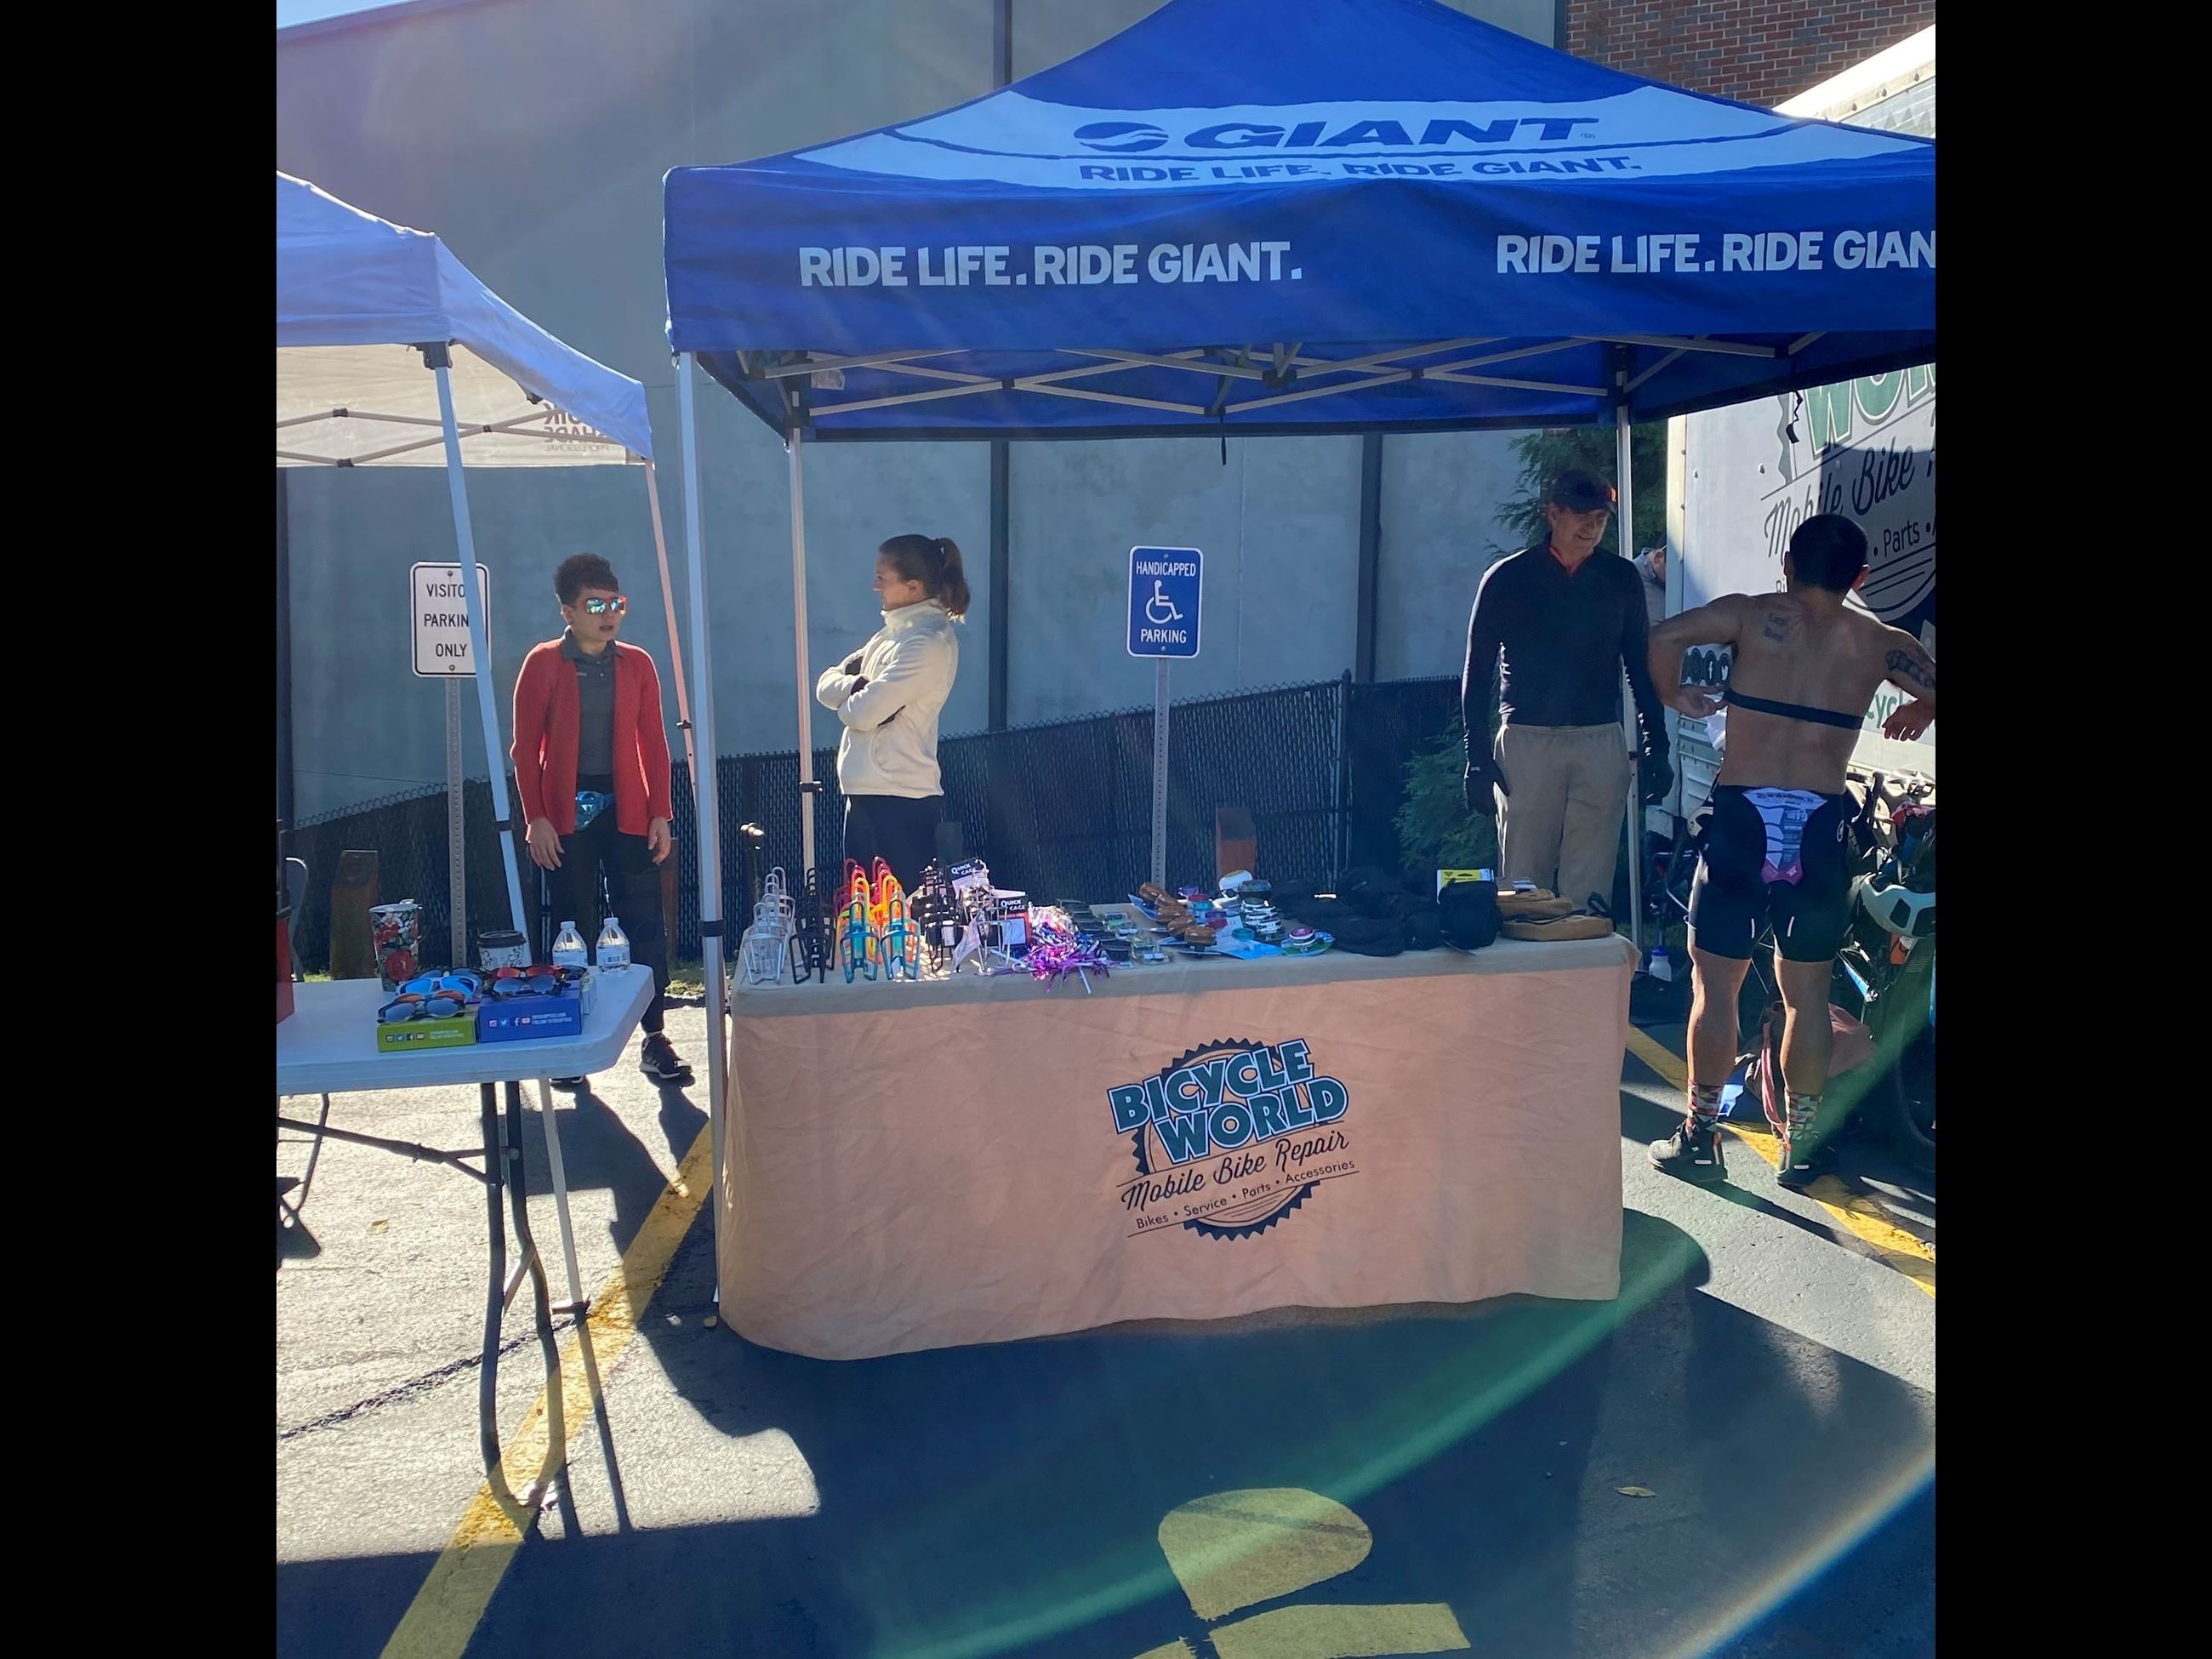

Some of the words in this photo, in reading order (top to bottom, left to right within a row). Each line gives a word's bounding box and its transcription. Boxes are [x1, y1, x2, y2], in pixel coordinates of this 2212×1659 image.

[1183, 117, 1599, 149] GIANT
[1080, 165, 1200, 182] RIDE
[1211, 164, 1332, 179] LIFE.
[1341, 162, 1462, 176] RIDE
[1471, 156, 1643, 175] GIANT.
[799, 247, 908, 287] RIDE
[918, 245, 1027, 287] LIFE.
[1035, 244, 1138, 285] RIDE
[1147, 241, 1303, 284] GIANT.
[1497, 235, 1601, 274] RIDE
[1611, 233, 1715, 273] LIFE.
[1723, 231, 1824, 272] RIDE
[1851, 436, 1916, 516] Bike
[1883, 520, 1920, 557] Parts
[1136, 561, 1196, 577] HANDICAPPED
[426, 584, 466, 598] VISITO
[424, 613, 470, 627] PARKIN
[1140, 628, 1187, 644] PARKING
[436, 643, 467, 657] ONLY
[1106, 1038, 1315, 1135] BICYCLE
[1154, 1075, 1349, 1166] WORLD
[1120, 1168, 1206, 1212] Mobile
[1213, 1153, 1267, 1185] Bike
[1274, 1130, 1350, 1172] Repair
[1136, 1211, 1170, 1230] Bikes
[1183, 1196, 1228, 1217] Service
[1241, 1182, 1272, 1200] Parts
[1285, 1159, 1356, 1185] Accessories
